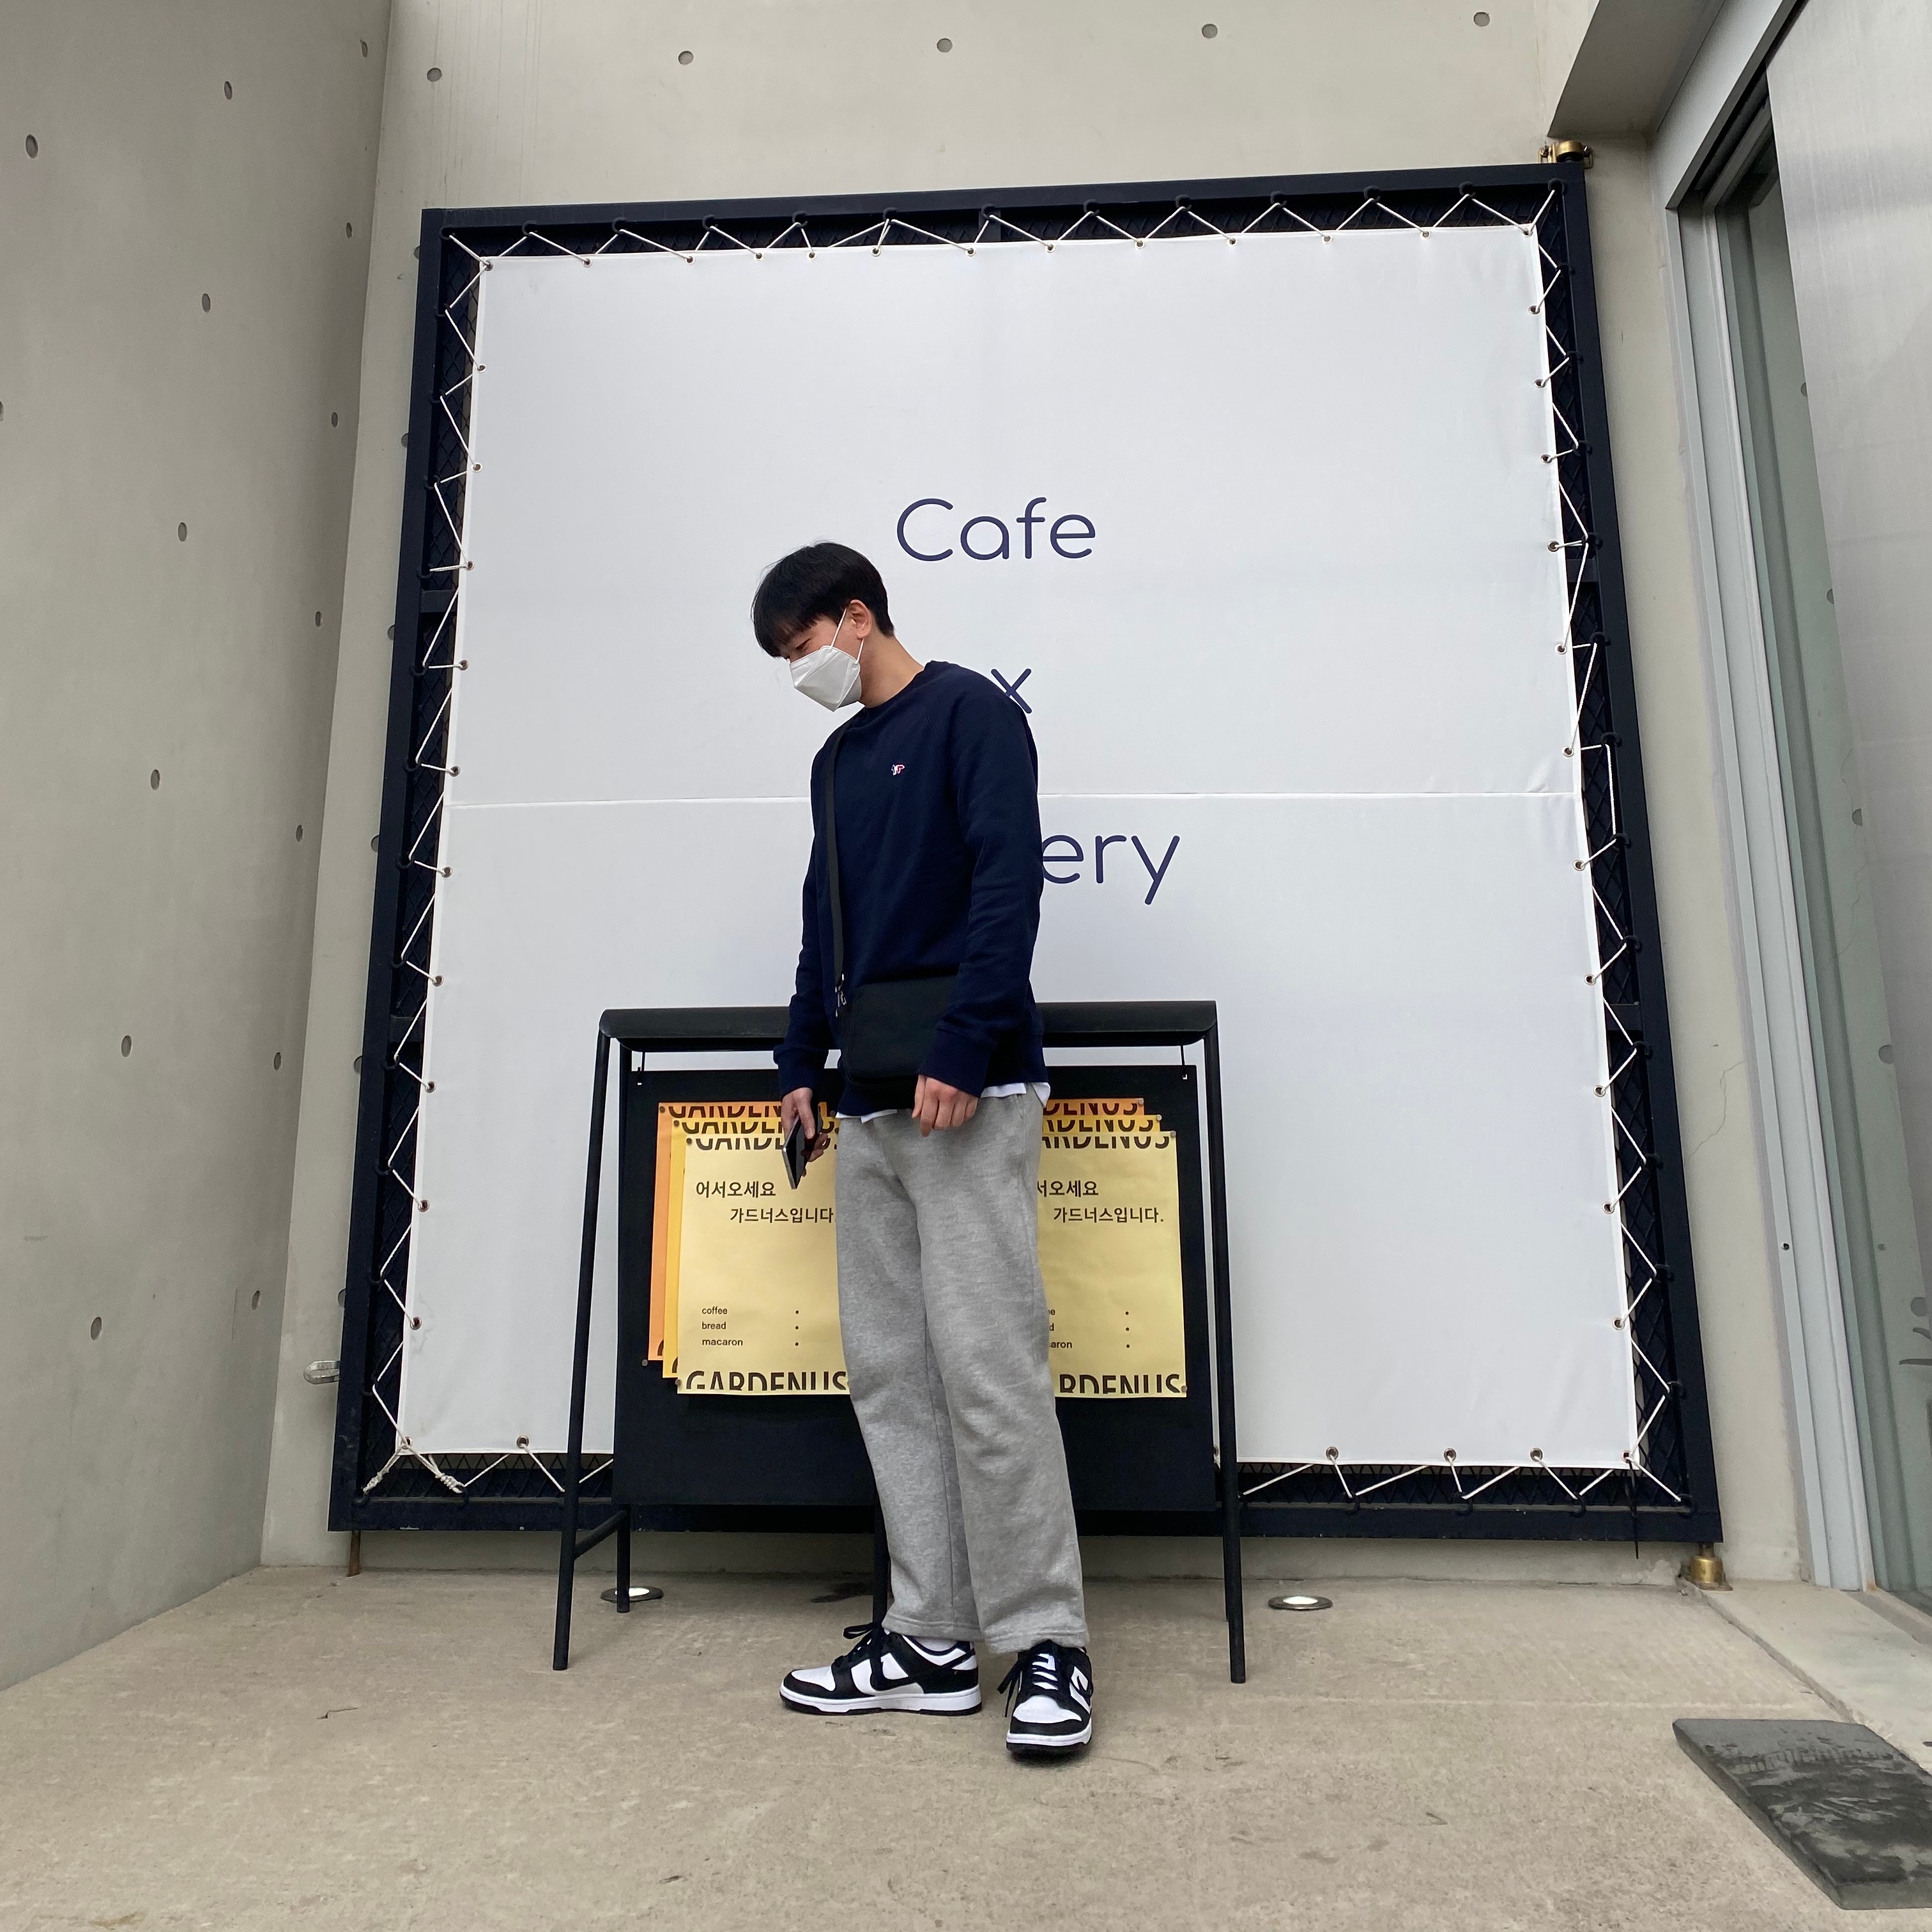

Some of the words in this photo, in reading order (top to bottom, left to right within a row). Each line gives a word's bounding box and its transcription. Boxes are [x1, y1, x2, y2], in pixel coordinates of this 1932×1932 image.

[896, 496, 1096, 562] Cafe
[990, 668, 1032, 714] x
[1043, 834, 1180, 905] ery
[696, 1181, 776, 1198] 어서오세요
[1037, 1179, 1099, 1197] 서오세요
[1053, 1206, 1164, 1223] 가드너스입니다.
[702, 1306, 728, 1315] coffee
[702, 1321, 726, 1330] bread
[1059, 1374, 1181, 1394] RDENUS
